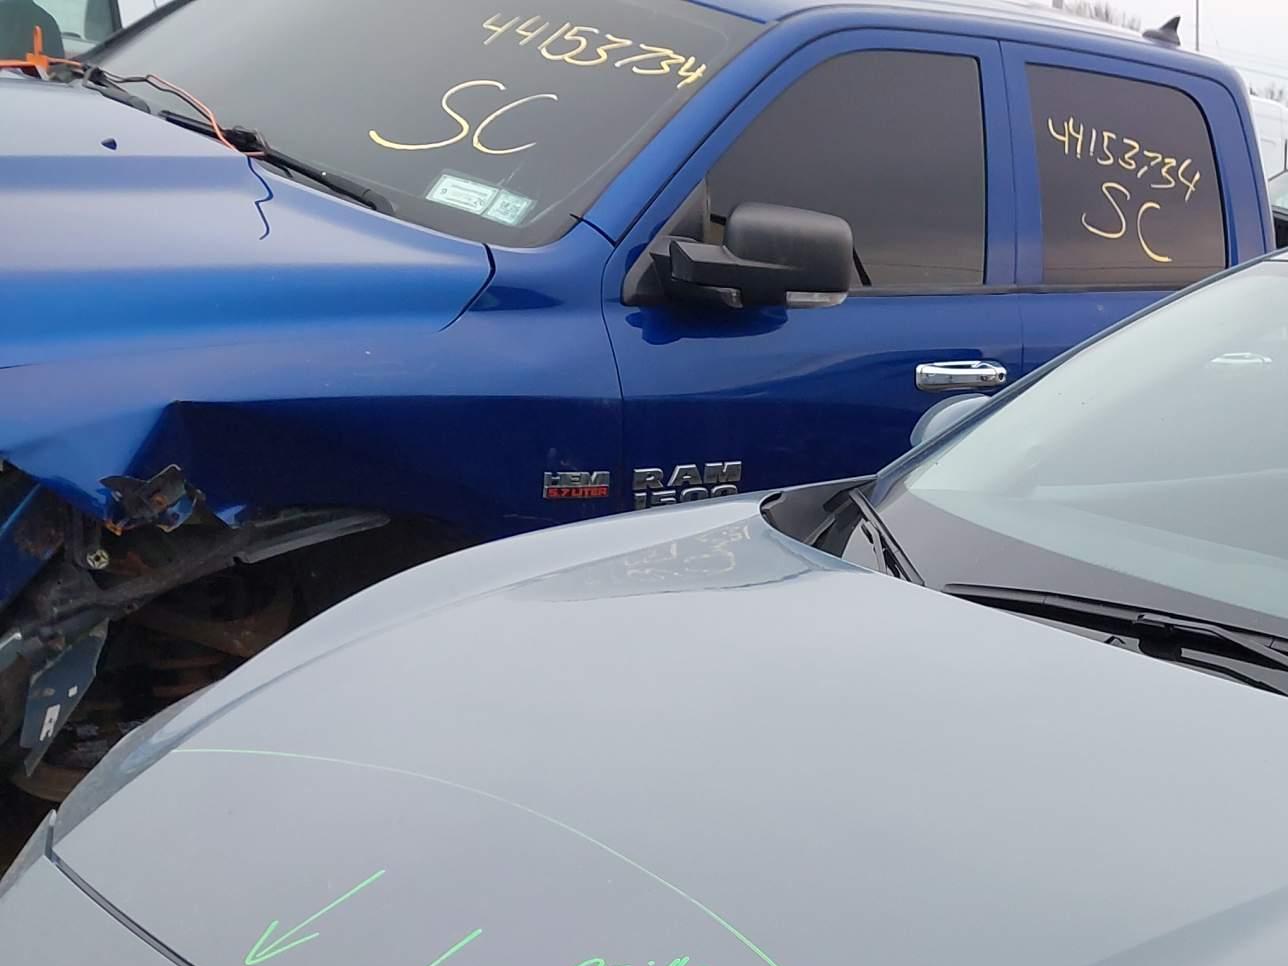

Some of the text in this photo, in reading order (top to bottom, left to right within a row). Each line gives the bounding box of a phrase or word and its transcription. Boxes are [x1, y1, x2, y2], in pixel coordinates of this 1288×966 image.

[482, 12, 706, 88] 44153734
[369, 79, 558, 154] SC
[1047, 117, 1200, 202] 44153734
[1081, 182, 1173, 262] SC
[571, 486, 608, 497] LITER
[632, 461, 742, 490] RAM
